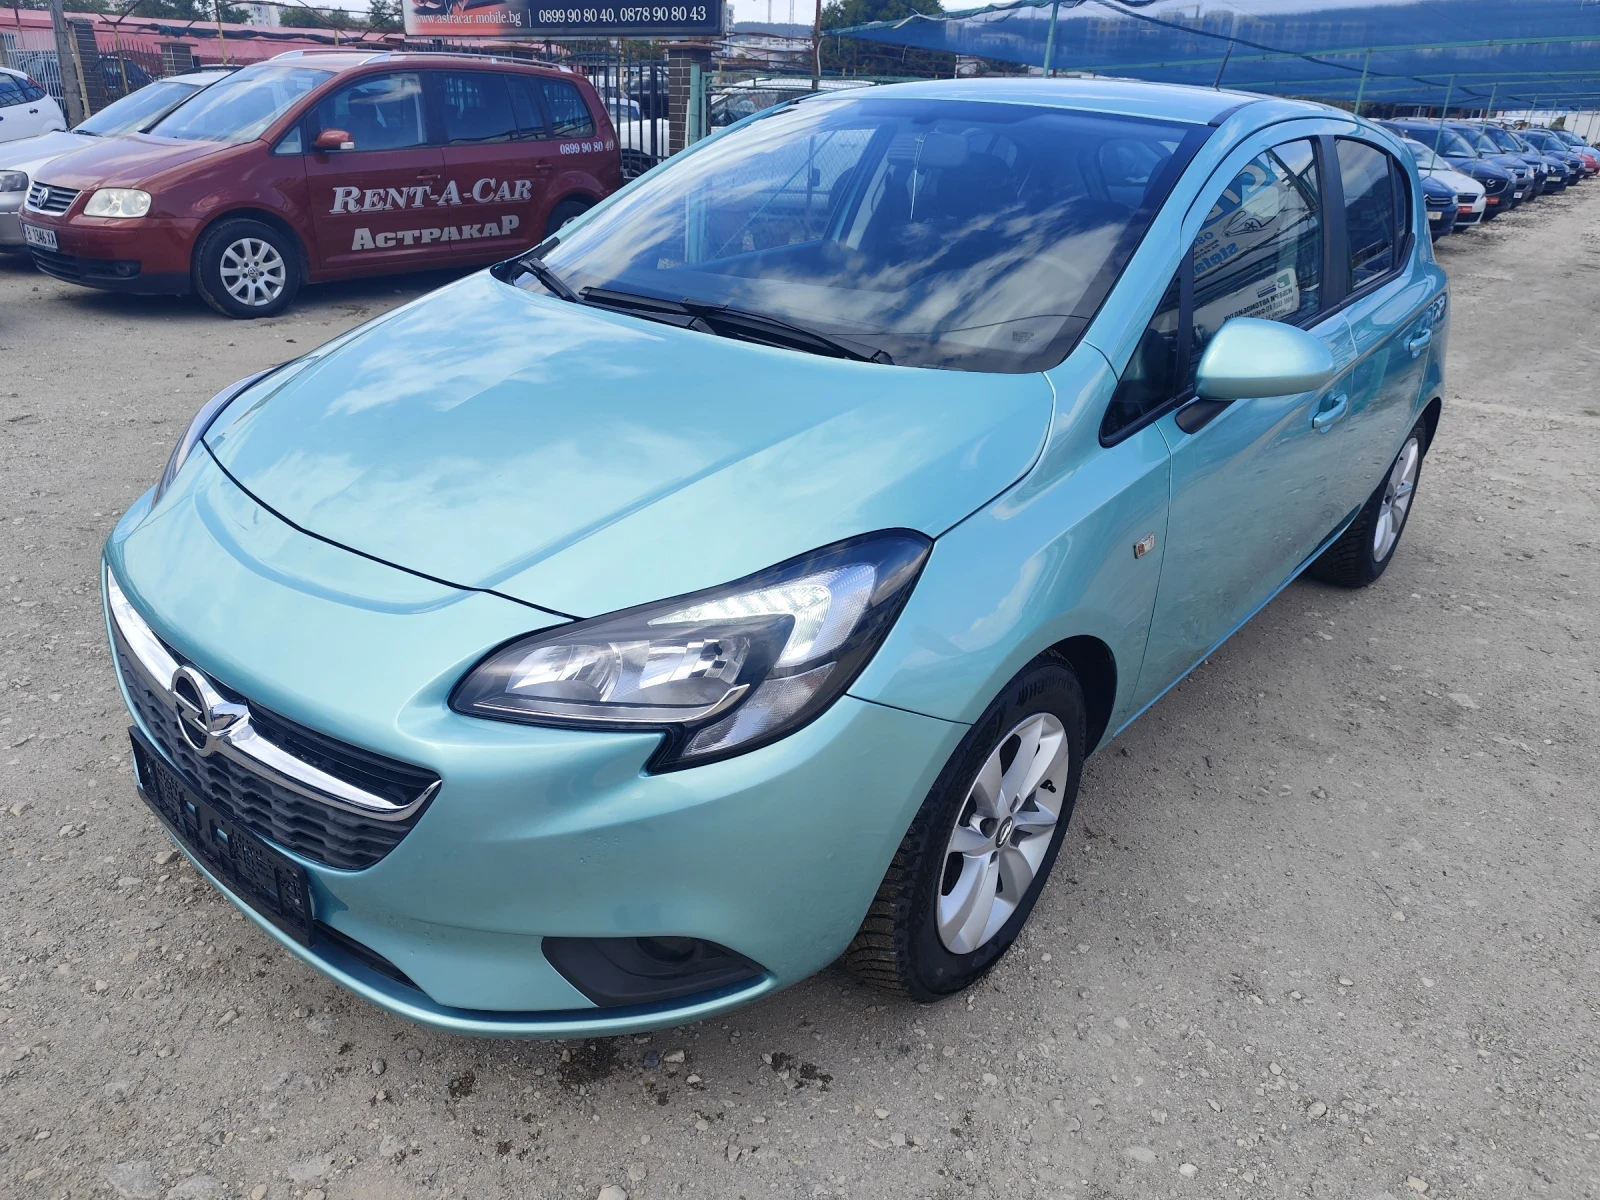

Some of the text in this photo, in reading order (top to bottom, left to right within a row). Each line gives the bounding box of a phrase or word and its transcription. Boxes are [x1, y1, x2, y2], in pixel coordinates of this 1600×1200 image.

[414, 12, 522, 27] www.astracar.mobile.bg
[539, 5, 707, 24] 0899 90 80 40, 0878 90 80 43
[560, 140, 614, 155] 0899 90 80 40
